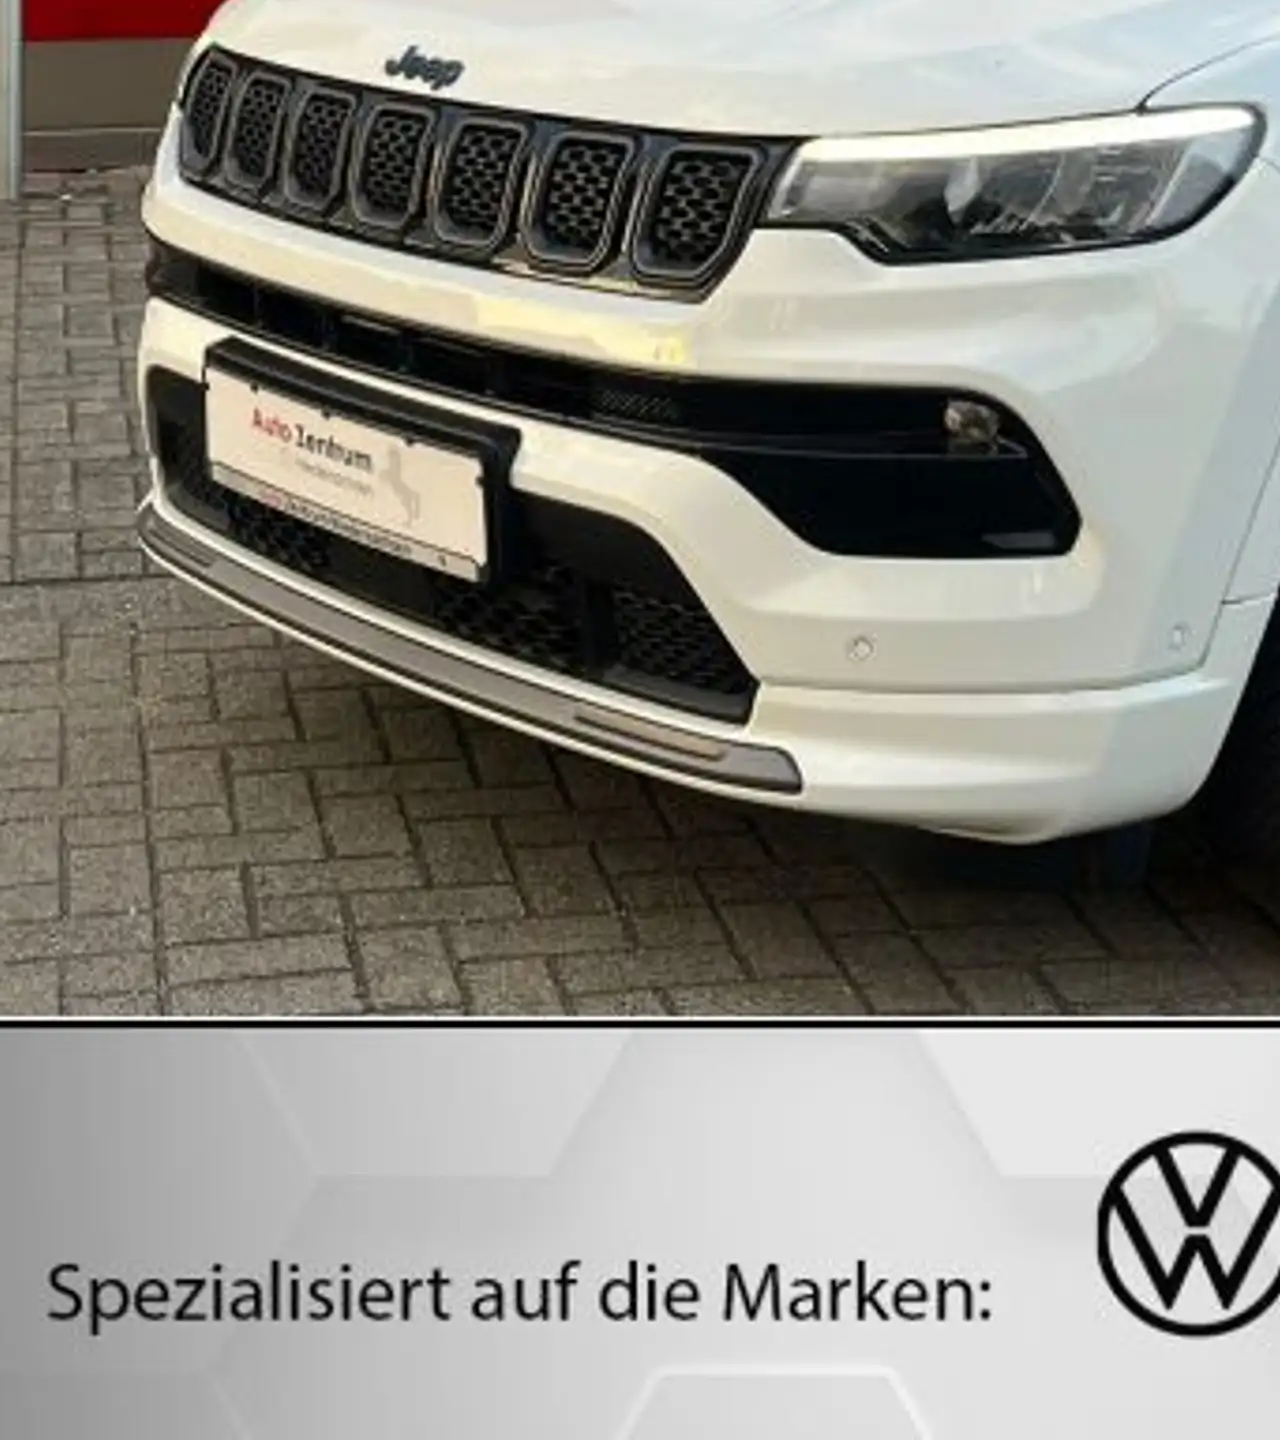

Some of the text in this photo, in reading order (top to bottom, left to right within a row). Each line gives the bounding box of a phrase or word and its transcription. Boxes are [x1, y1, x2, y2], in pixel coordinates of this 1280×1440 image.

[384, 45, 465, 90] Jeep
[250, 407, 375, 473] Auto Zentrum
